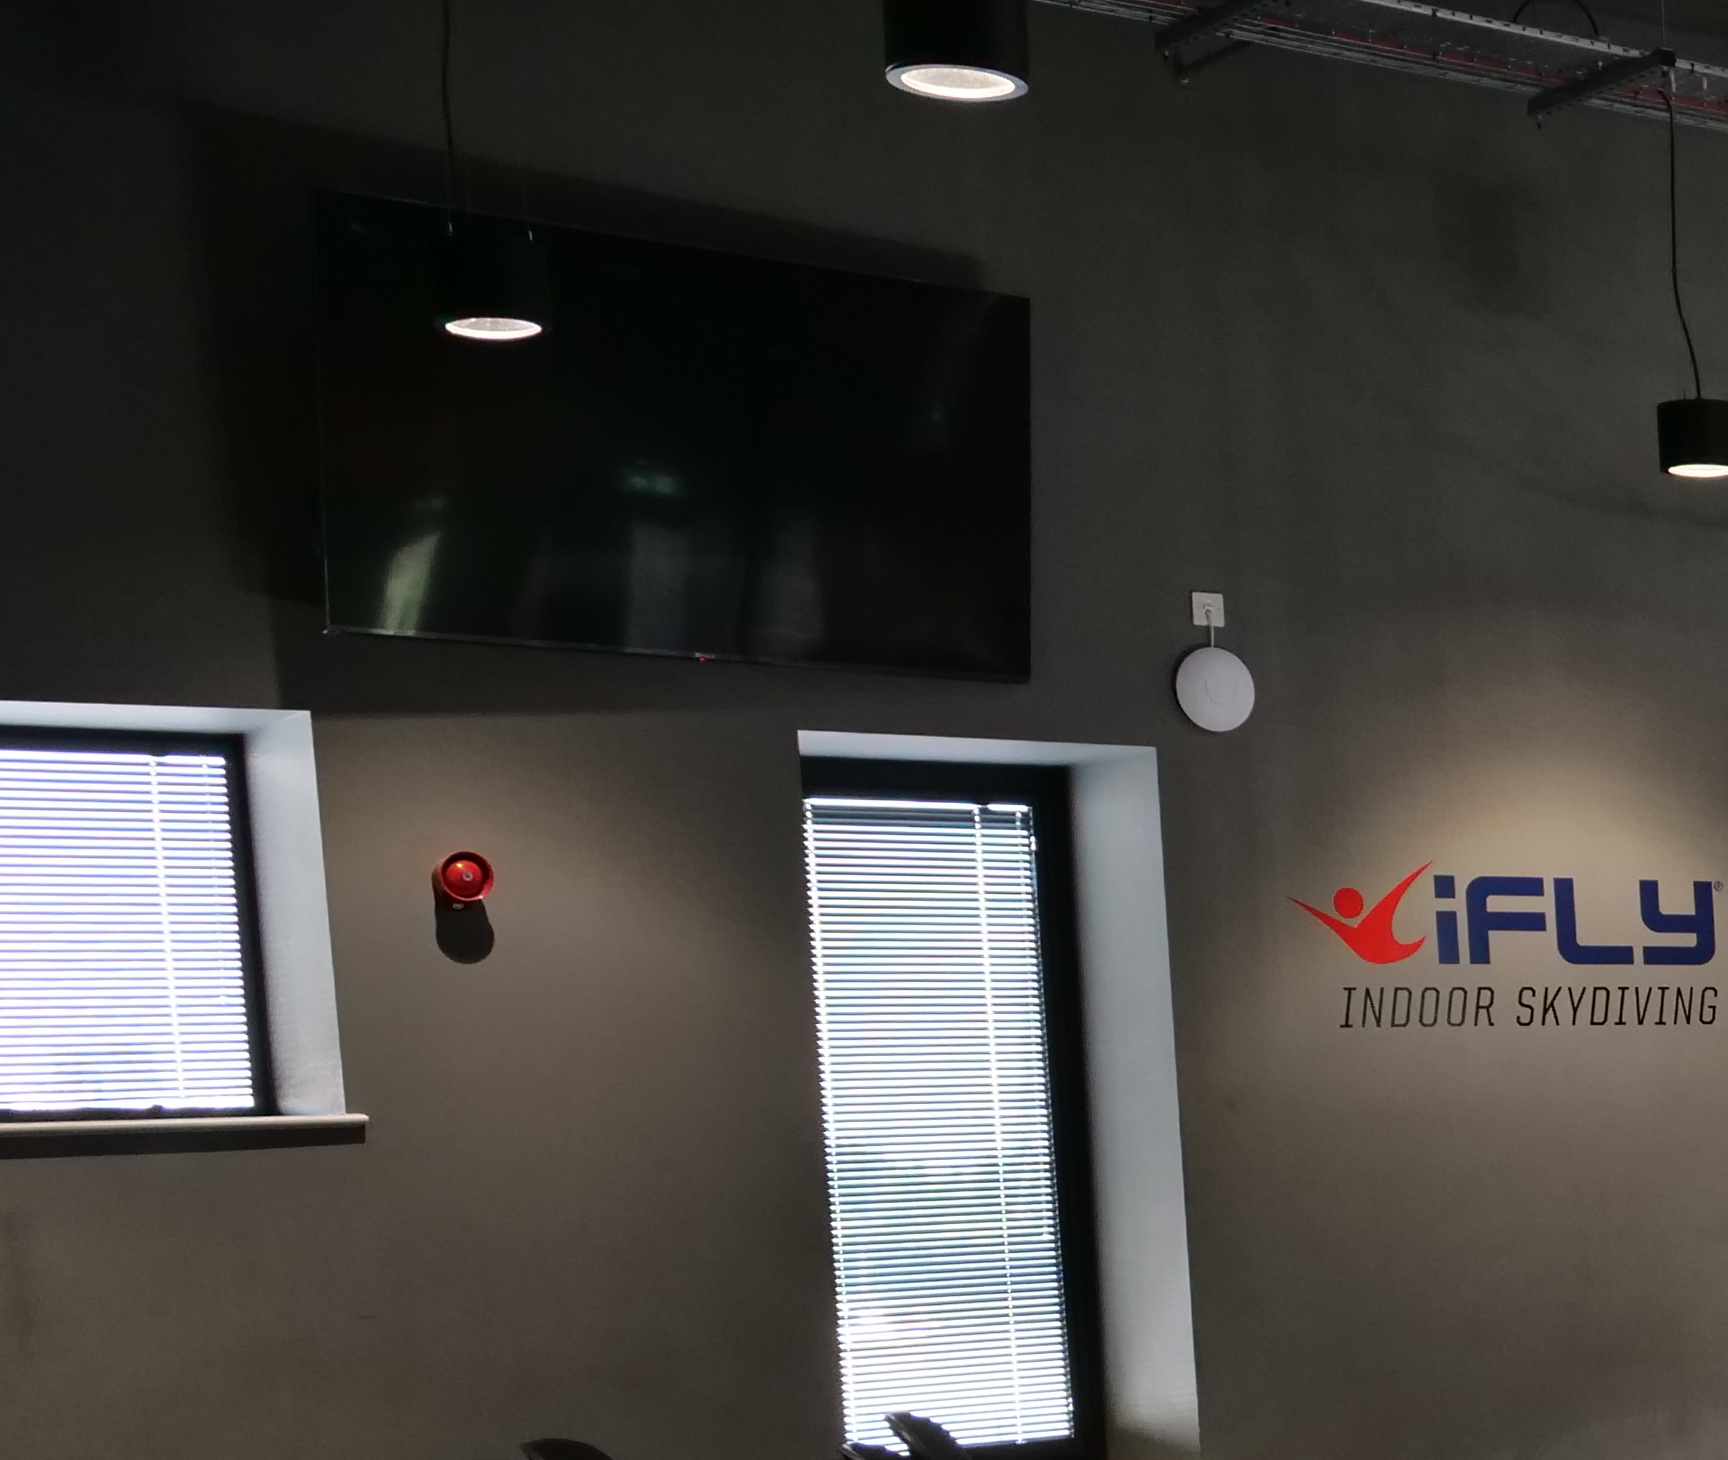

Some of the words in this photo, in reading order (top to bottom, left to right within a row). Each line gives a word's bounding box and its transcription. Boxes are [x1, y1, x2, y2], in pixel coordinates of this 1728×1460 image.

[1433, 875, 1716, 965] iFLY
[1339, 987, 1495, 1028] INDOOR
[1516, 987, 1718, 1026] SKYDIVING
